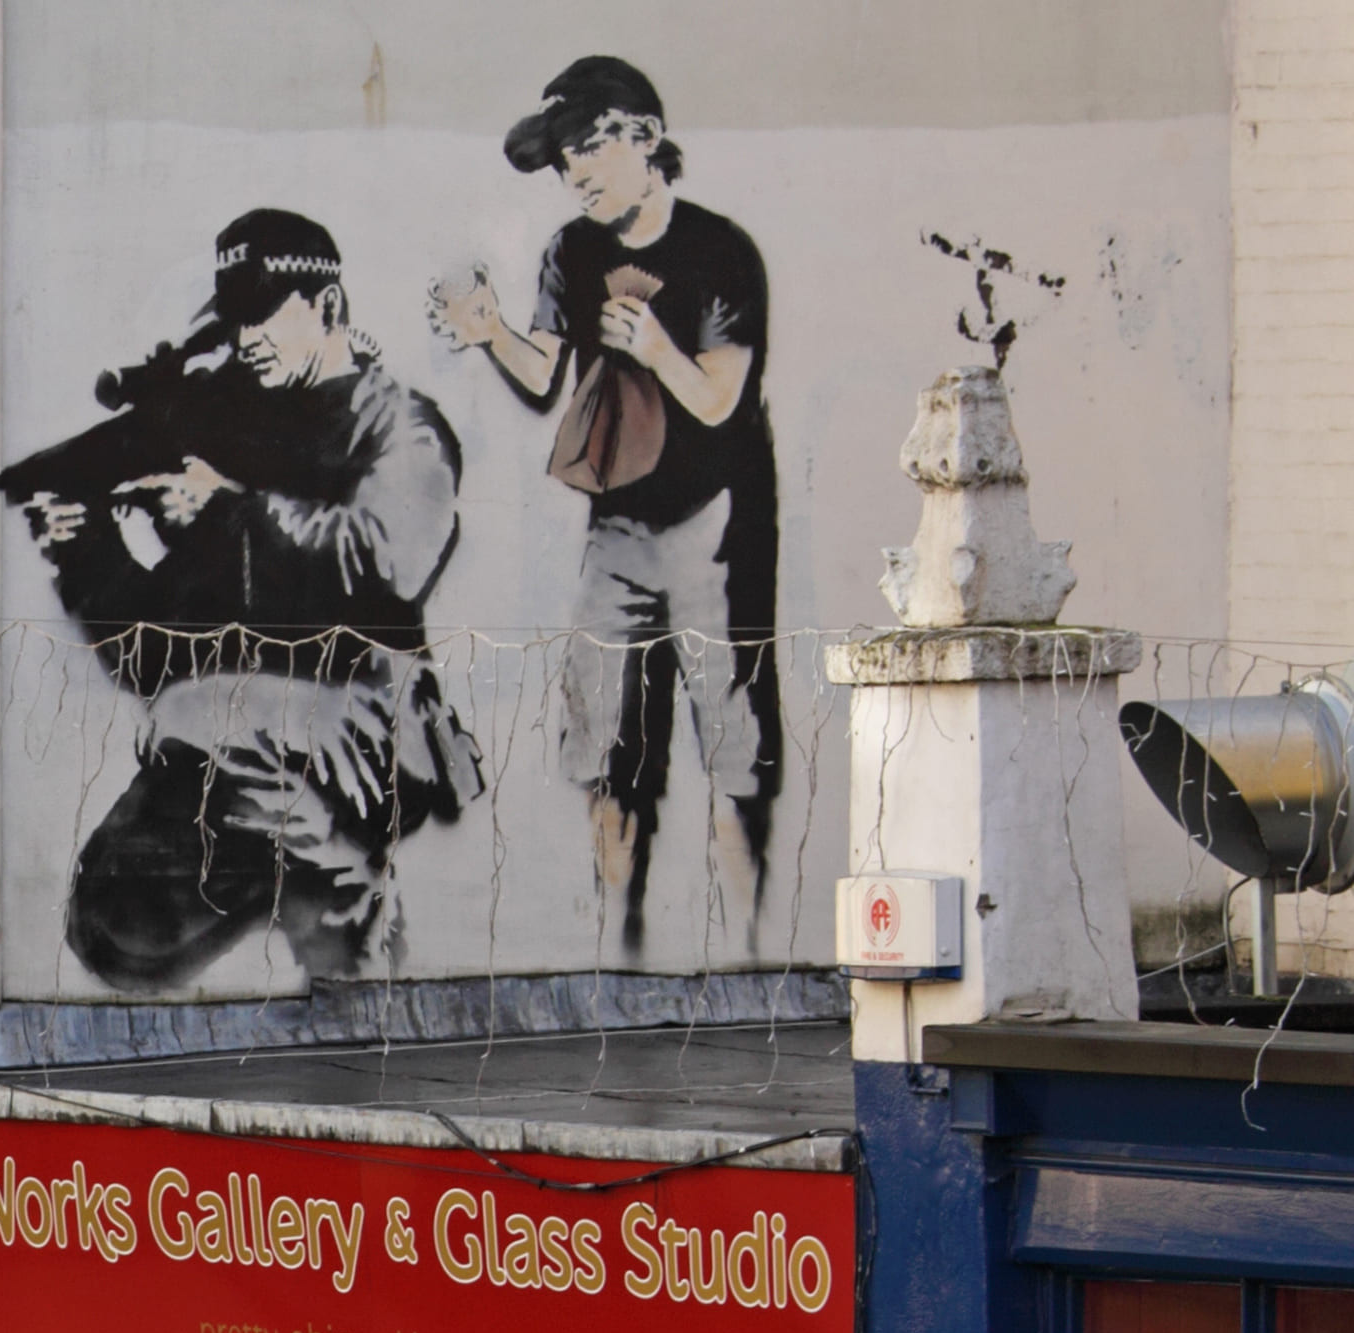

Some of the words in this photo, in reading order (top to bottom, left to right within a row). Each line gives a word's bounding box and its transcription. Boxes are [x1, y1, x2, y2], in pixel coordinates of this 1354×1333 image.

[148, 1167, 364, 1293] Gallery
[384, 1197, 418, 1265] &
[434, 1188, 606, 1294] Glass
[621, 1201, 831, 1313] Studio
